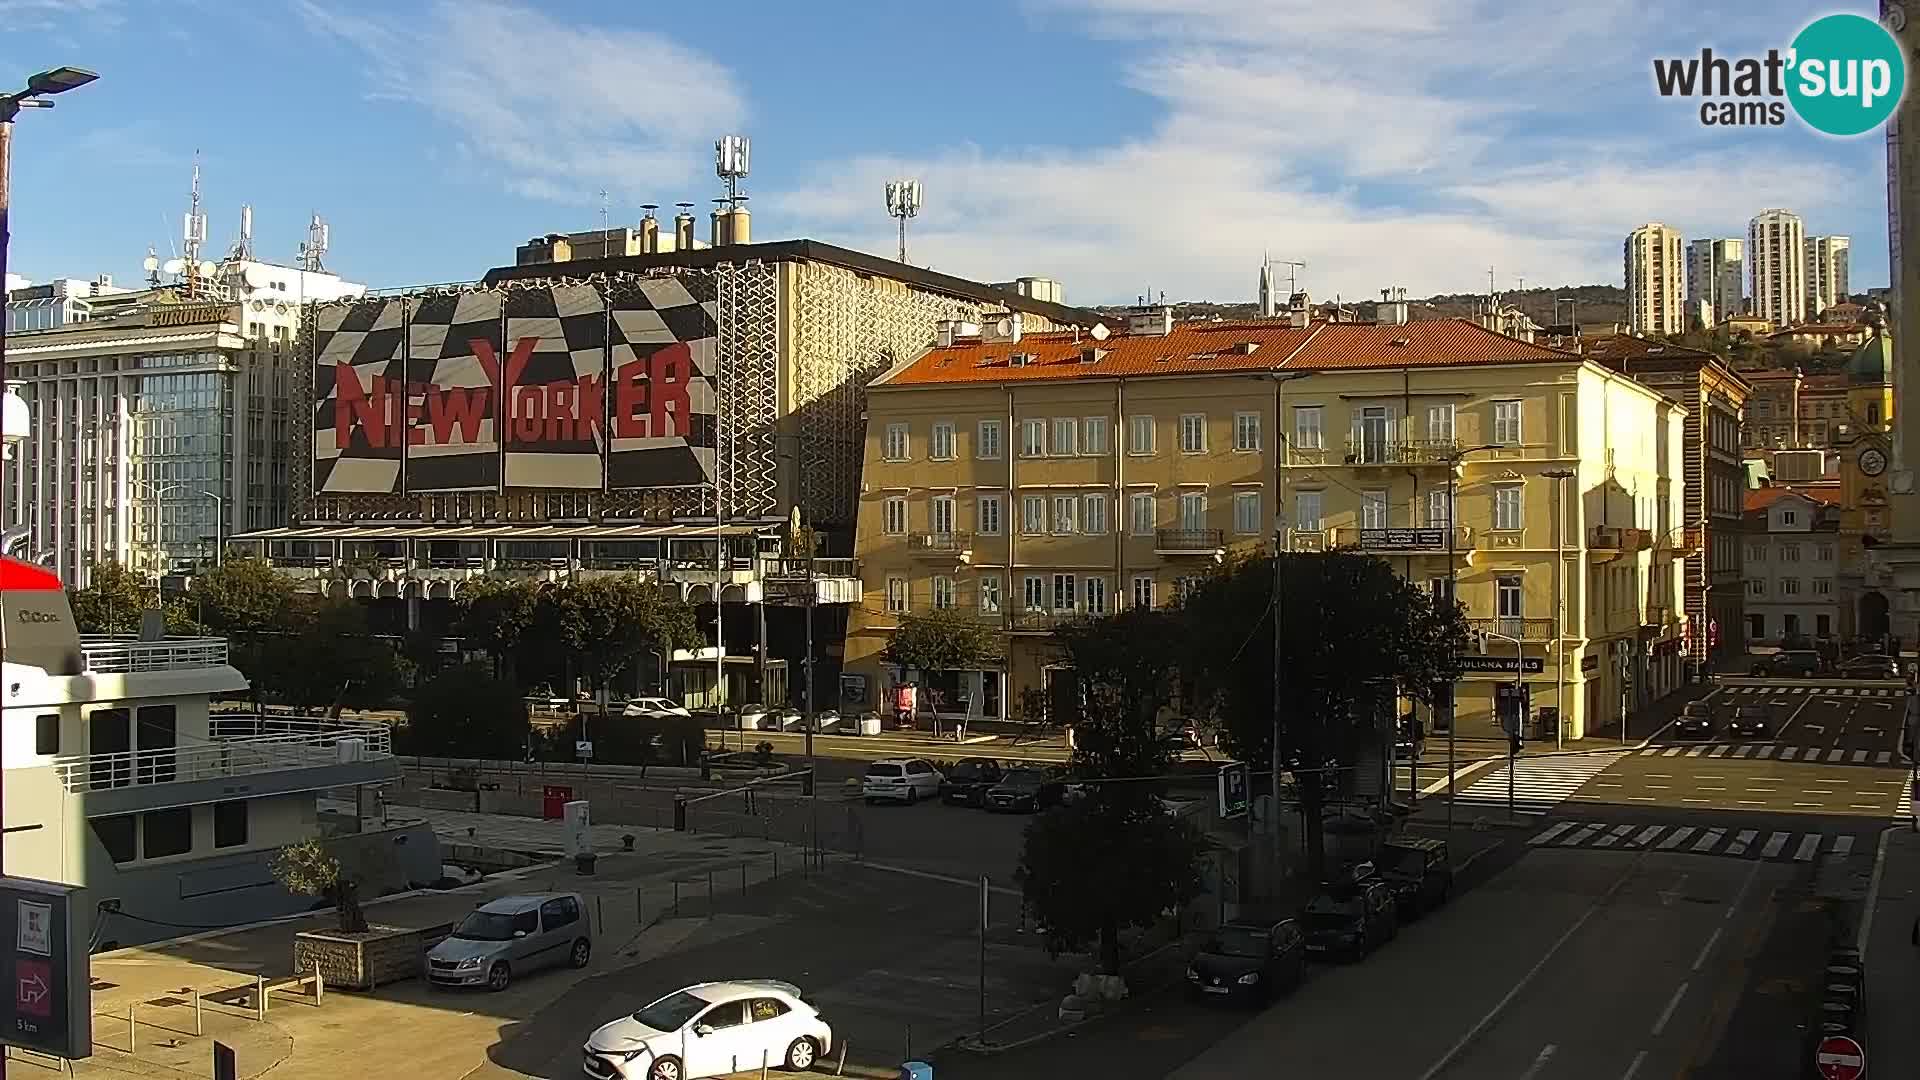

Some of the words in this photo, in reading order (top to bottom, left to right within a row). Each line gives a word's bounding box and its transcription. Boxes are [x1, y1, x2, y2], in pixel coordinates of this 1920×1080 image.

[335, 359, 490, 449] NEW
[468, 336, 692, 444] YORKER
[1456, 659, 1503, 669] JULIANA
[1506, 661, 1538, 670] NAILS
[16, 1018, 23, 1030] 5
[24, 1020, 38, 1033] km
